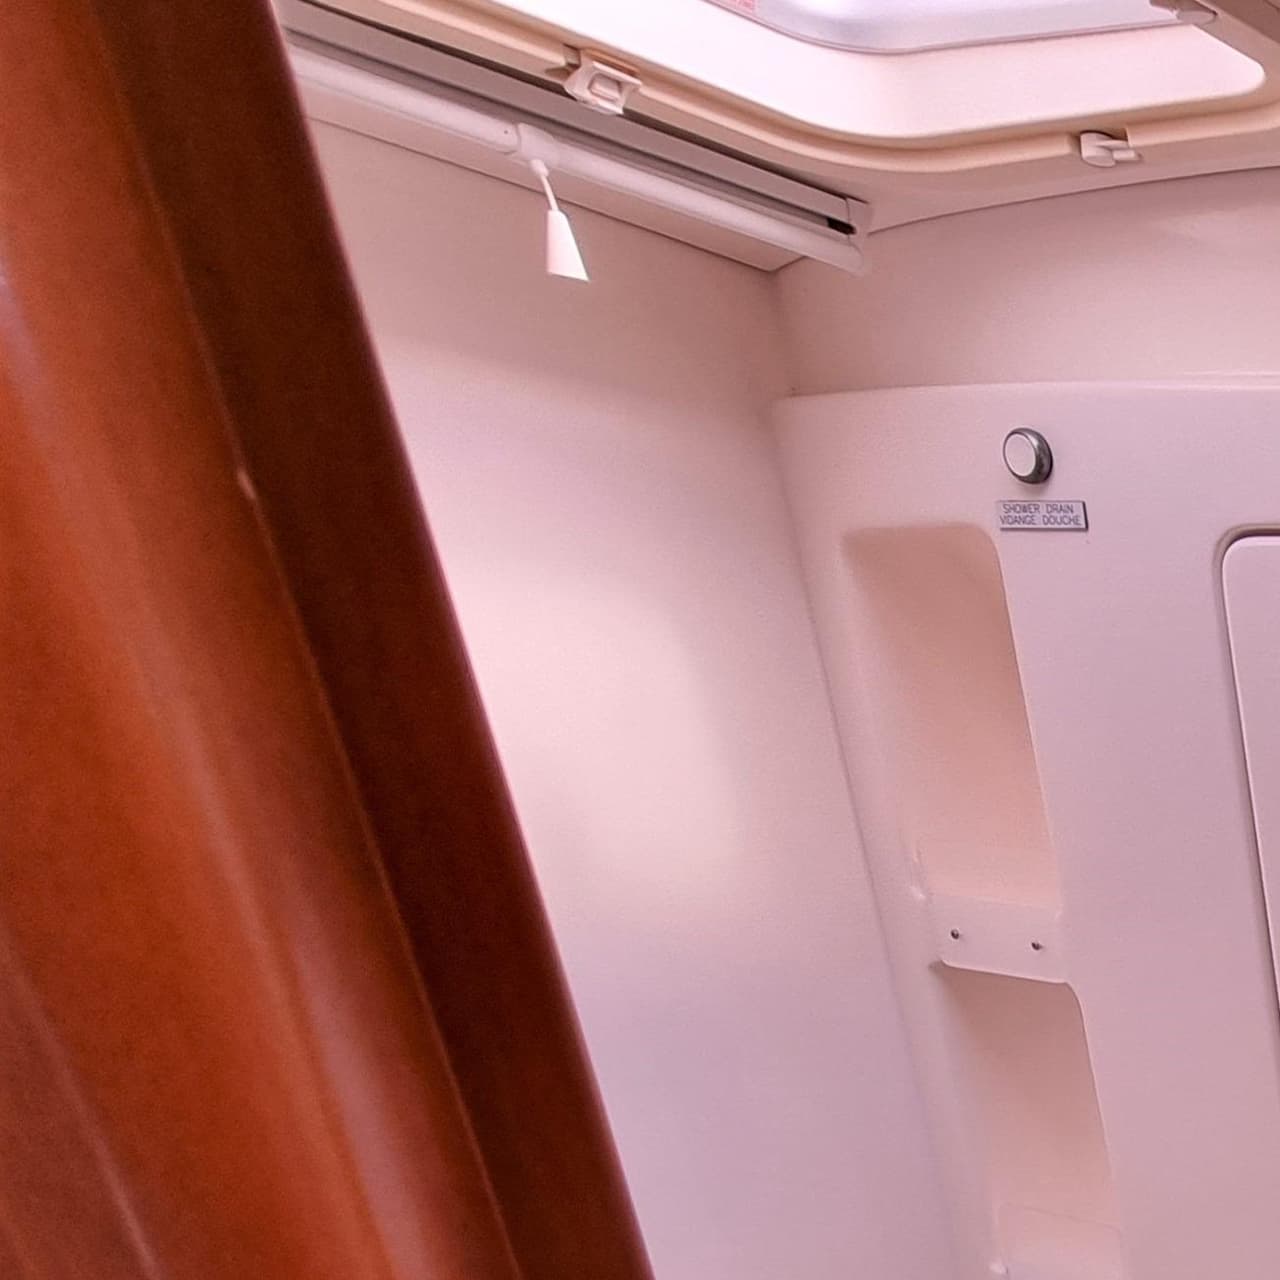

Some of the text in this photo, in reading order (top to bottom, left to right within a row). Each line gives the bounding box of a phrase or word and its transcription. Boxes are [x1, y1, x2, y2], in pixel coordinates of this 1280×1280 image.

[1002, 503, 1074, 514] SHOWER DRAIN
[1042, 515, 1082, 525] DOUCHE
